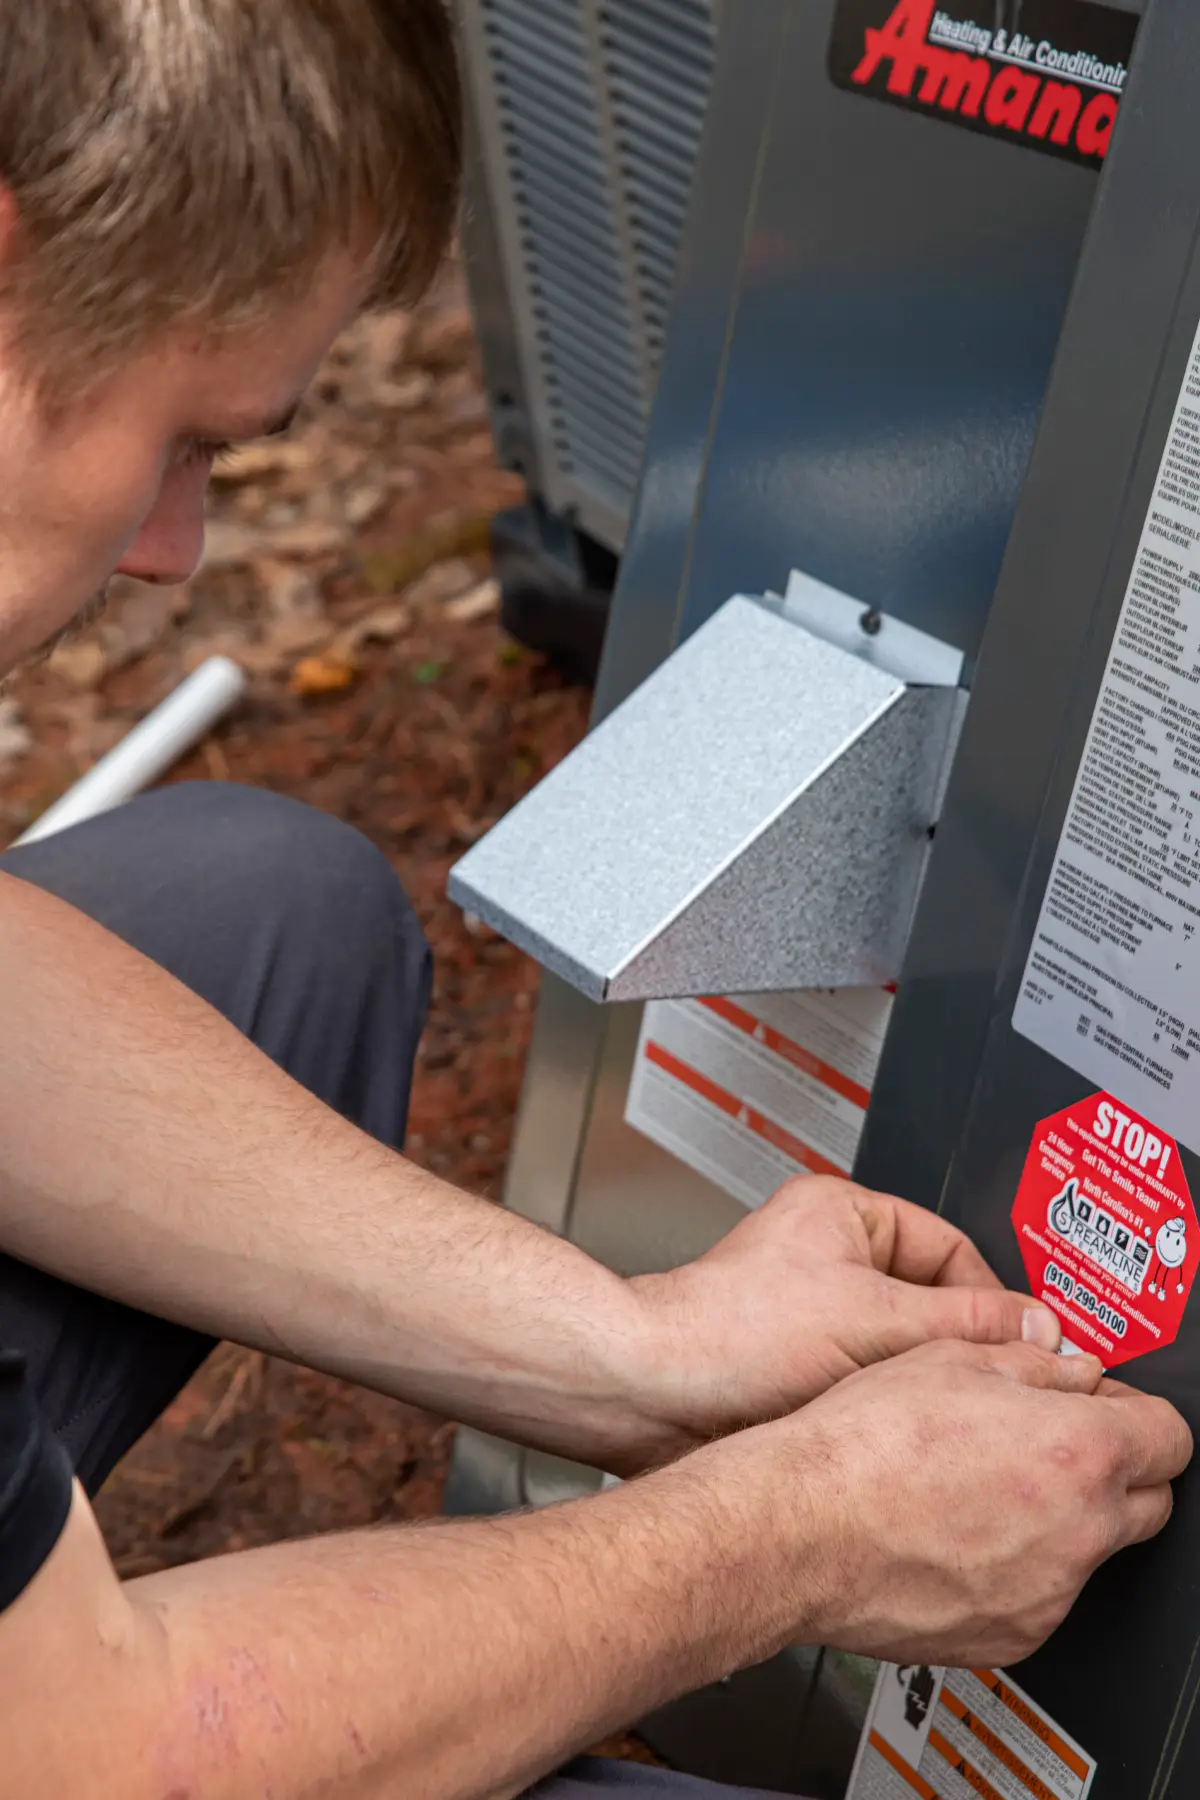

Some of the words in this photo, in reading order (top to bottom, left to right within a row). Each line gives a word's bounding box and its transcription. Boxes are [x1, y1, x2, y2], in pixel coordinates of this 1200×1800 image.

[930, 10, 992, 53] Heating
[993, 29, 1008, 51] &
[1007, 33, 1036, 58] Air
[851, 0, 1118, 157] Amana
[1039, 1139, 1076, 1175] Emergency
[1040, 1156, 1066, 1182] Service
[1056, 1137, 1074, 1156] Hour
[1066, 1117, 1079, 1133] This
[1078, 1128, 1108, 1154] equipment
[1107, 1148, 1121, 1164] may
[1120, 1156, 1129, 1168] be
[1128, 1162, 1145, 1180] under
[1145, 1174, 1178, 1203] WARRANTY
[1177, 1197, 1186, 1211] by
[1093, 1101, 1172, 1180] STOP!
[1082, 1148, 1097, 1168] Get
[1097, 1158, 1112, 1178] The
[1112, 1170, 1136, 1195] Smile
[1136, 1186, 1160, 1214] Team!
[1083, 1177, 1102, 1199] North
[1101, 1190, 1136, 1224] Carolina's
[1134, 1213, 1144, 1229] #1
[1022, 1224, 1054, 1255] Plumbing,
[1078, 1268, 1104, 1294] Heating,
[1110, 1292, 1120, 1305] Air
[1120, 1300, 1161, 1339] Conditioning
[1044, 1227, 1060, 1243] How
[1083, 1258, 1102, 1274] make
[1101, 1272, 1115, 1286] you
[1115, 1281, 1136, 1300] smile?
[1059, 1211, 1143, 1283] STREAMLINE
[1041, 1290, 1114, 1354] smileteamnow.com
[1046, 1263, 1074, 1297] (919)
[1074, 1286, 1125, 1335] 299-0100
